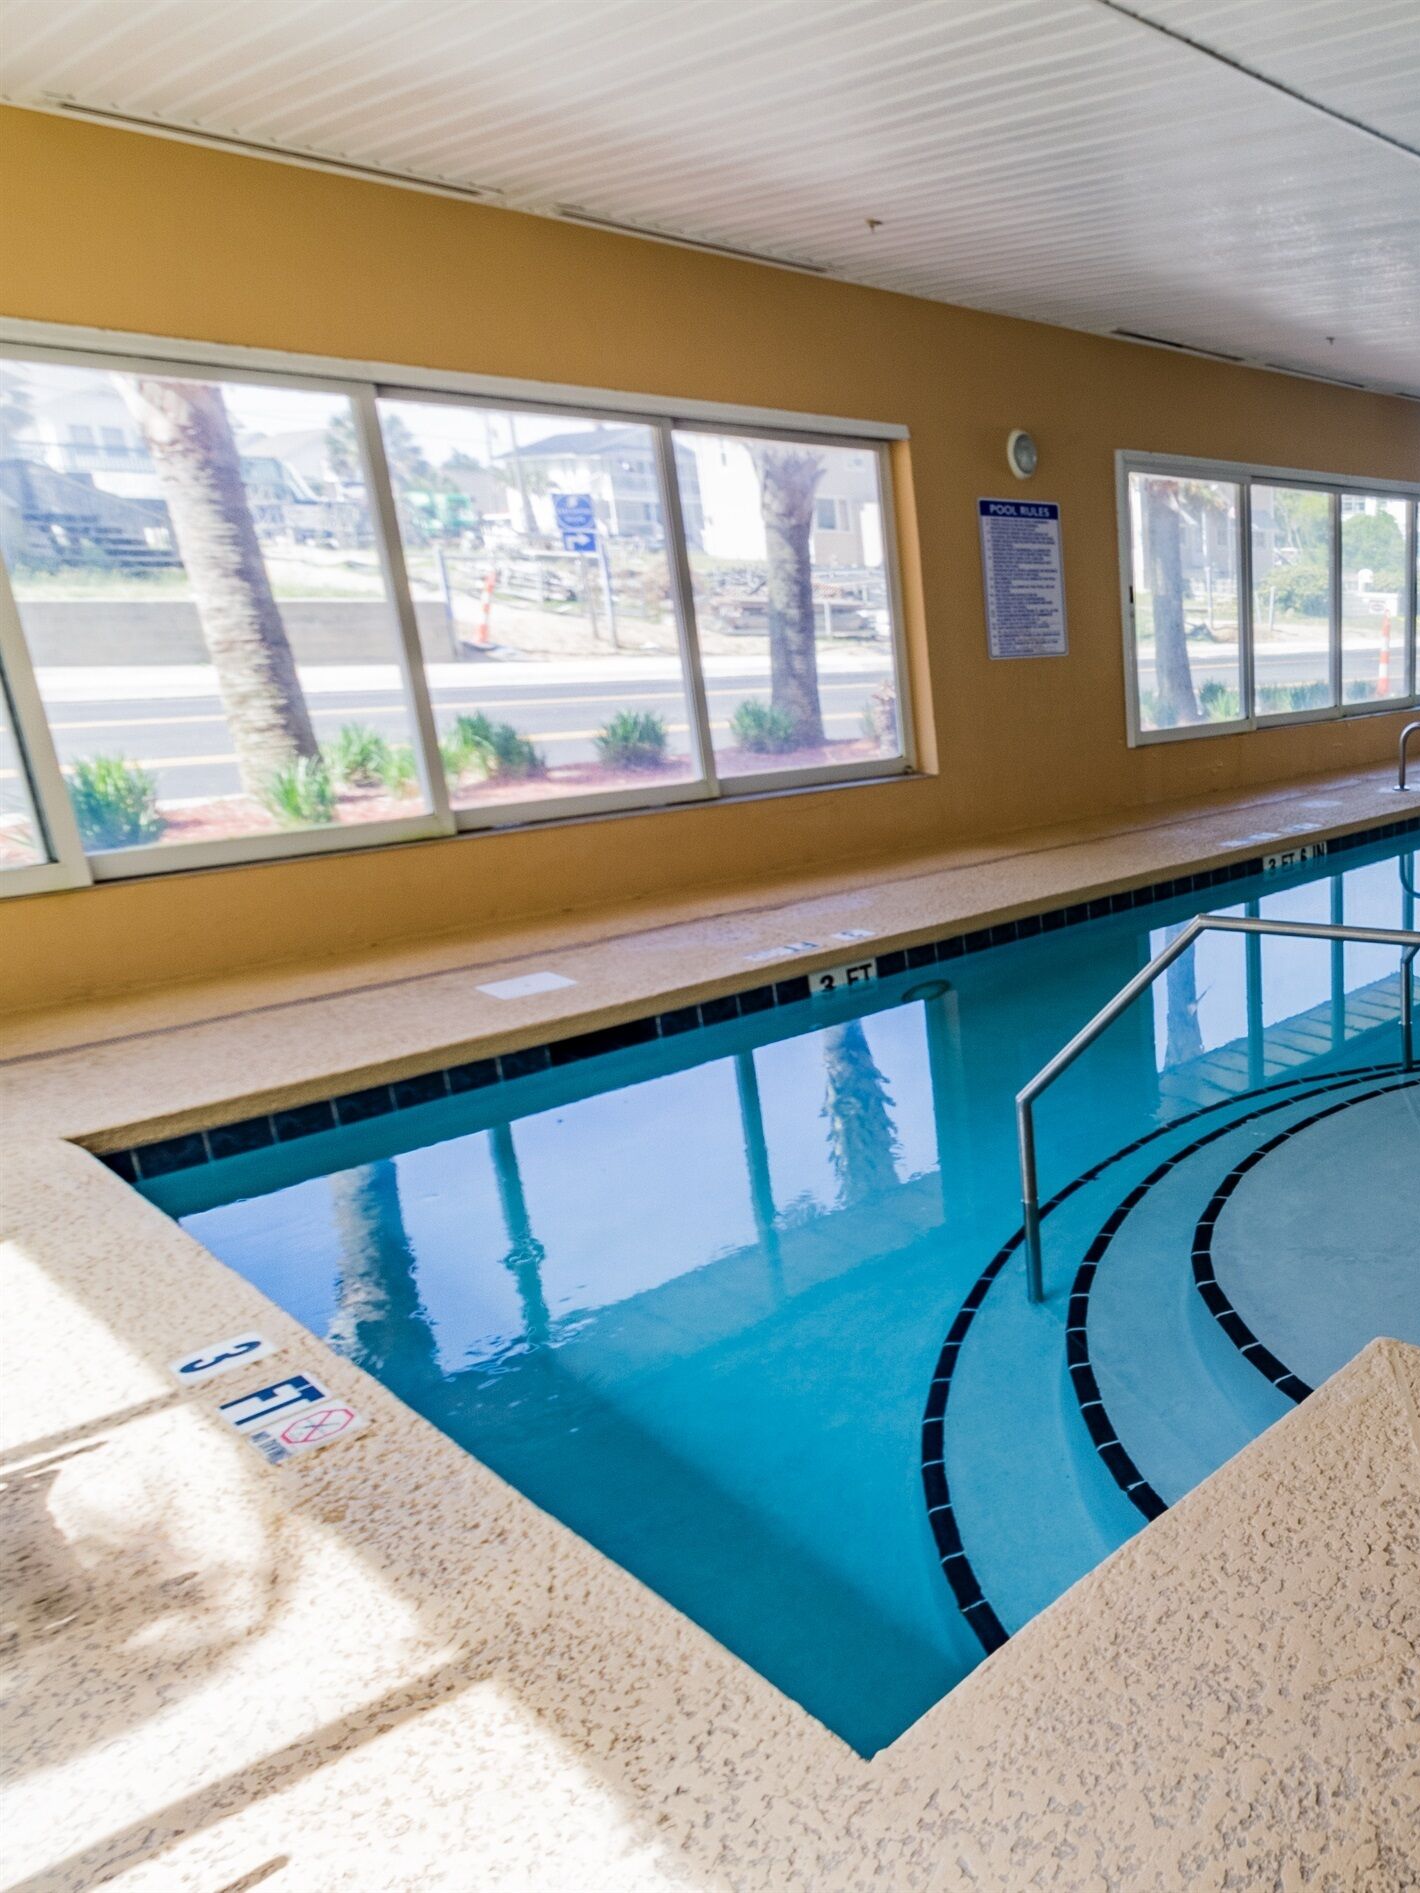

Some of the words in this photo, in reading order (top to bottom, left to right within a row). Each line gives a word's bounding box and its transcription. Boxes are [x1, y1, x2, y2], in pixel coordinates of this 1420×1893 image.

[989, 503, 1018, 516] POOL
[1019, 505, 1050, 518] RULES
[846, 963, 872, 985] FT
[179, 1340, 262, 1374] 3
[219, 1375, 326, 1426] FT
